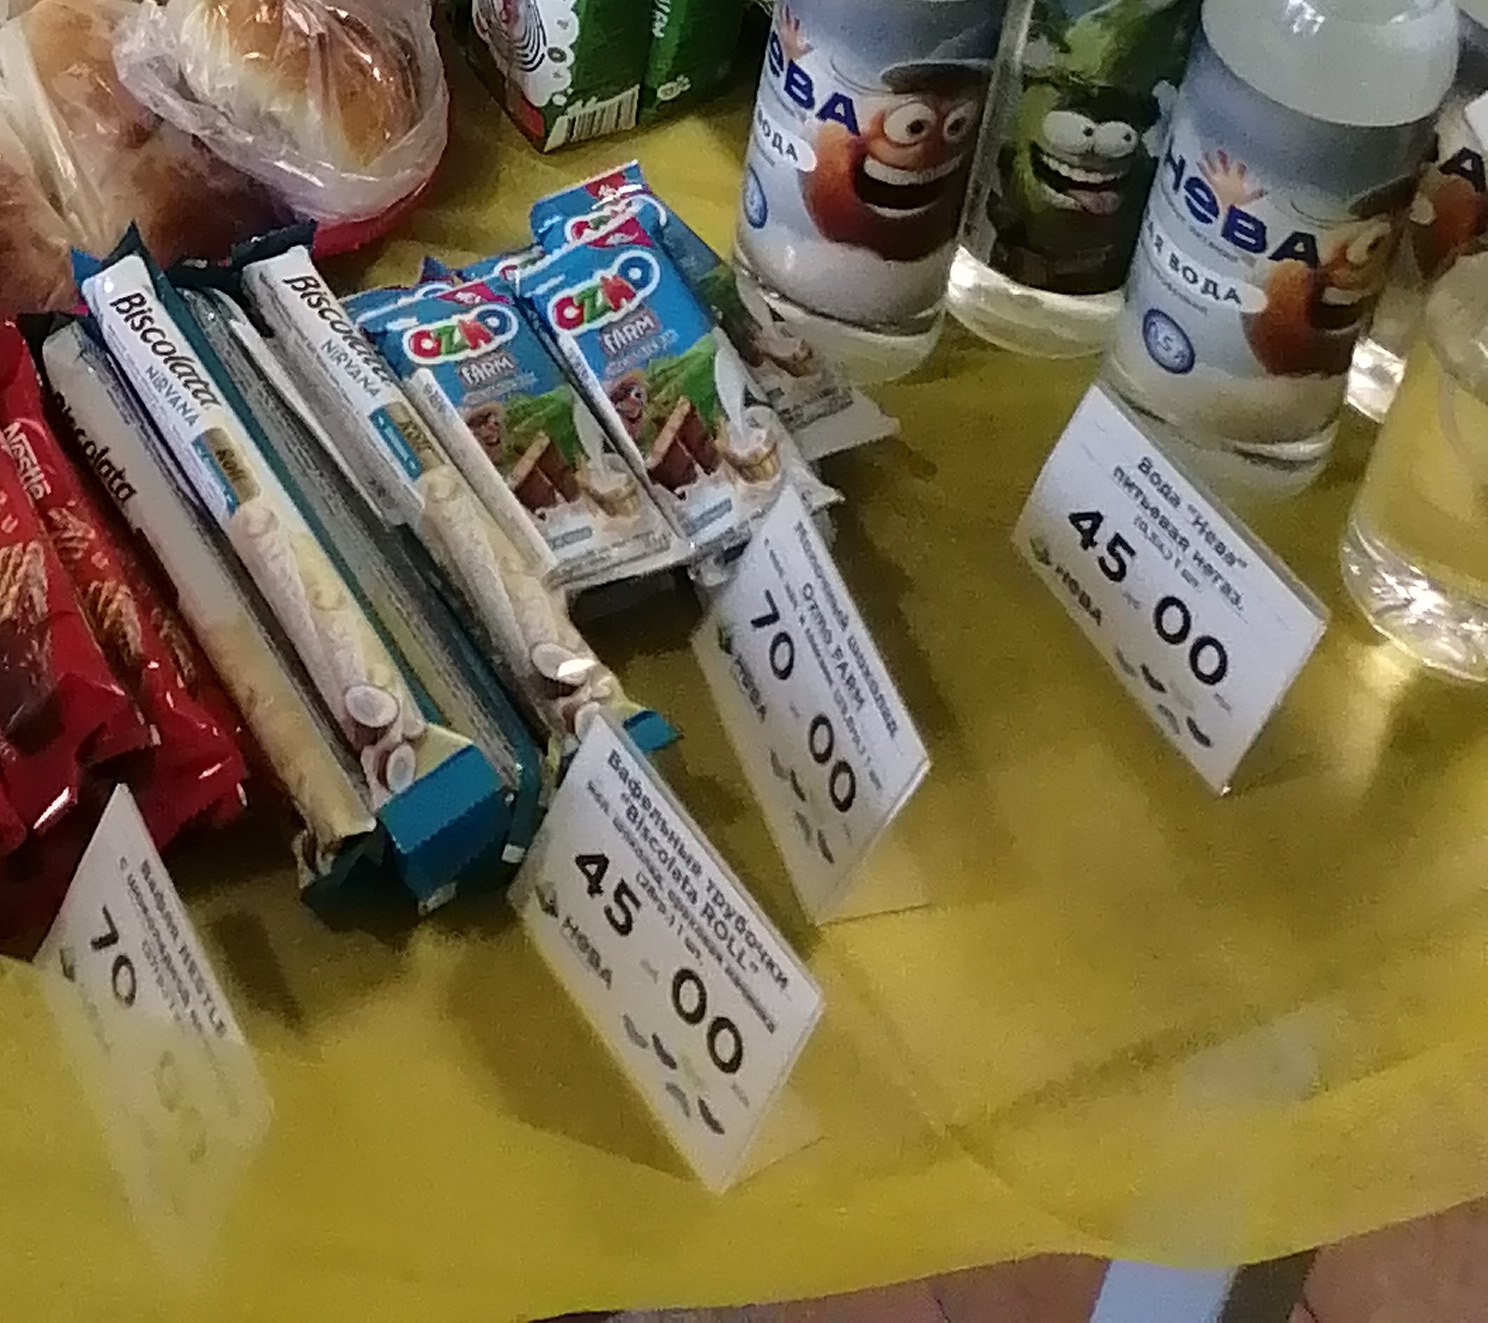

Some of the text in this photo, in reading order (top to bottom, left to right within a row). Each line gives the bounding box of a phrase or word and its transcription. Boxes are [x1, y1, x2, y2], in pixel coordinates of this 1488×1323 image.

[408, 307, 515, 360] OZMO
[552, 253, 659, 332] OZMO
[603, 314, 658, 354] FARM
[1168, 252, 1242, 306] ВОДА
[110, 290, 222, 410] Biscolata
[461, 356, 515, 389] FARM
[1112, 465, 1244, 611] питьевая негаз.
[1137, 456, 1248, 569] Вода "Нева"
[793, 520, 850, 633] Молочный
[847, 634, 899, 739] шоколад
[1068, 509, 1228, 686] 45 00
[750, 588, 857, 813] 70 00
[832, 644, 865, 711] FARM
[607, 749, 790, 989] Вафельные трубочки
[620, 792, 760, 974] "Biscolata ROLL"
[90, 904, 138, 1008] 70
[574, 852, 744, 1075] 45 00
